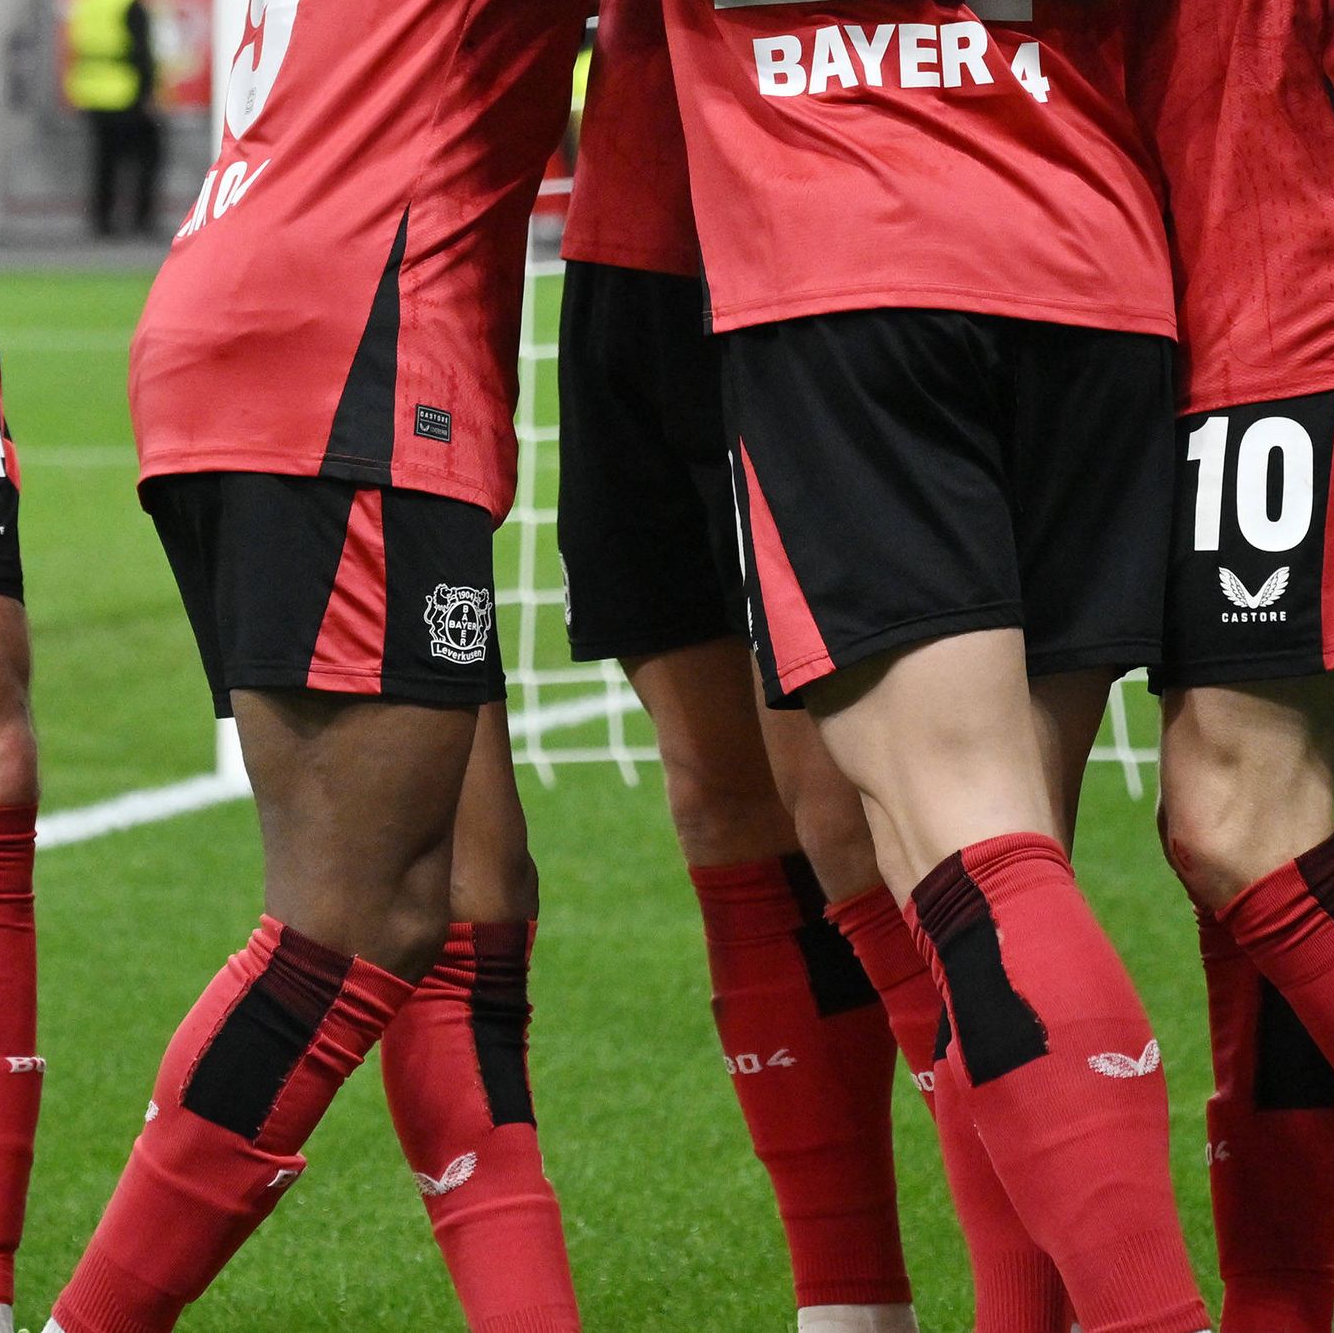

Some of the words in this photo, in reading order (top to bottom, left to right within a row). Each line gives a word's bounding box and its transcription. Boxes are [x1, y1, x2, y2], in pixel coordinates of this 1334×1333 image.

[753, 21, 994, 97] BAYER
[1187, 416, 1314, 552] 10
[1221, 611, 1287, 623] CASTORE
[436, 644, 482, 660] Leverkusen
